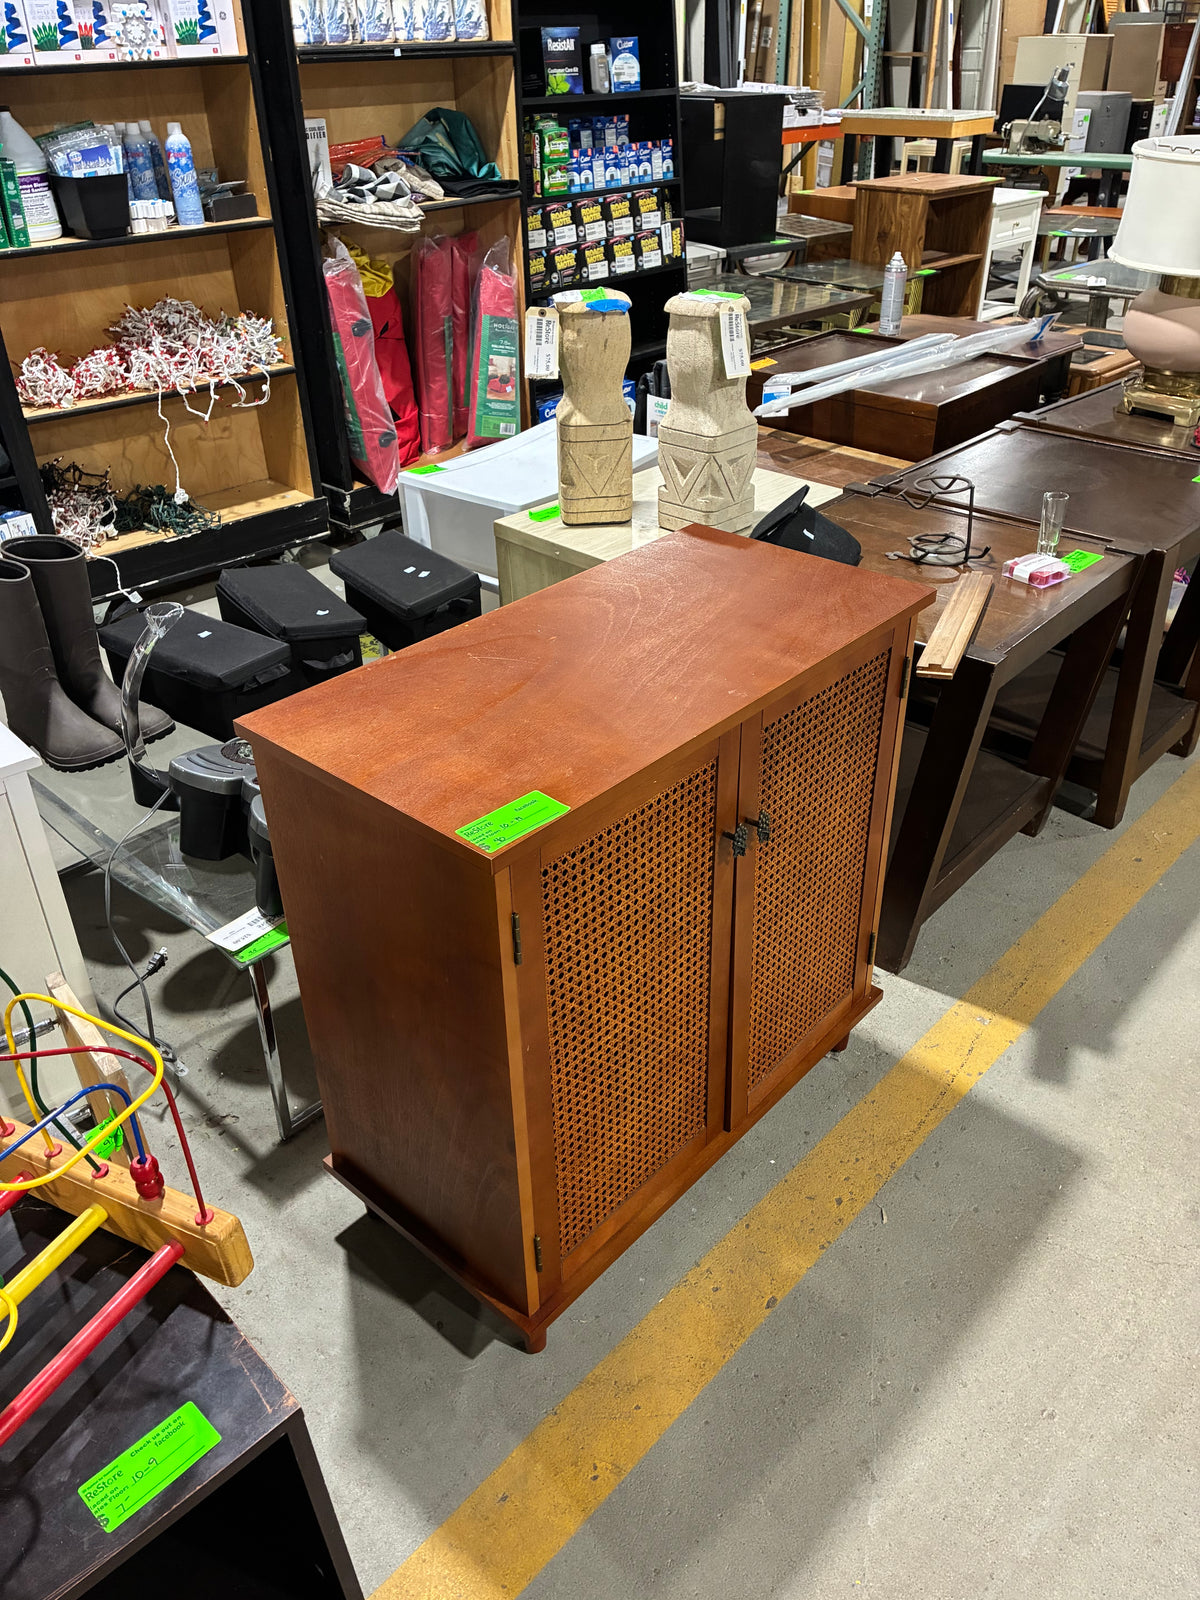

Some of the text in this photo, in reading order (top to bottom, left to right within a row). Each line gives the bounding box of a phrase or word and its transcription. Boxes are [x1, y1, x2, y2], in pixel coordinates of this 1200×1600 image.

[547, 39, 575, 51] ResistAll
[610, 201, 630, 212] ROACH
[638, 196, 658, 207] ROACH
[581, 205, 602, 217] ROACH
[612, 208, 630, 218] MOTEL
[640, 202, 658, 213] MOTEL
[550, 210, 572, 221] ROACH
[583, 212, 602, 224] MOTEL
[553, 217, 572, 228] MOTEL
[613, 241, 632, 252] ROACH
[640, 236, 658, 247] ROACH
[585, 246, 604, 258] ROACH
[554, 252, 576, 264] ROACH
[586, 253, 605, 264] MOTEL
[557, 259, 576, 270] MOTEL
[544, 320, 552, 344] ReStore
[464, 822, 493, 838] ReStore
[130, 1440, 151, 1457] Check
[152, 1432, 160, 1440] us
[161, 1422, 172, 1432] out
[154, 1422, 186, 1447] facebook
[85, 1470, 124, 1502] ReStore
[110, 1486, 118, 1494] on
